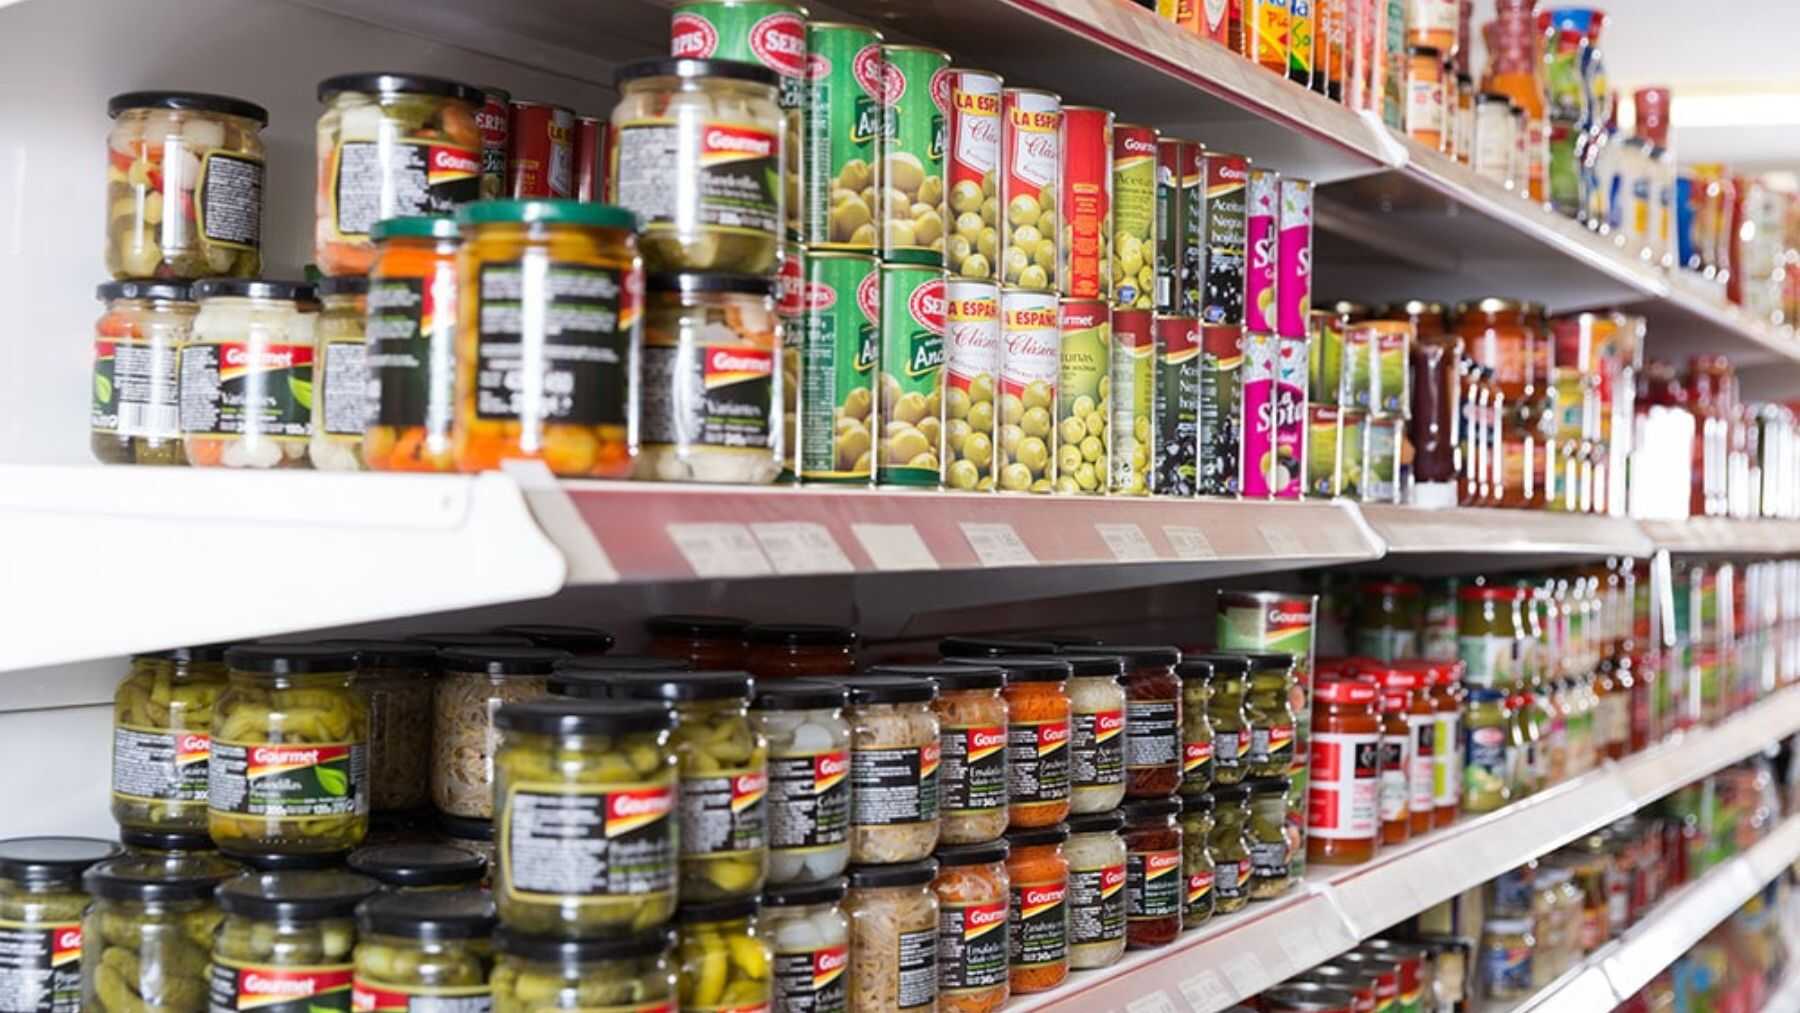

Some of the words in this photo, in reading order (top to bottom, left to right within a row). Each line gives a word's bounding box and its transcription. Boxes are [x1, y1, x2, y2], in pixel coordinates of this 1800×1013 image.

[957, 95, 973, 110] LA
[1013, 112, 1031, 126] LA
[254, 747, 319, 766] Gourmet
[244, 977, 315, 994] Gourmet
